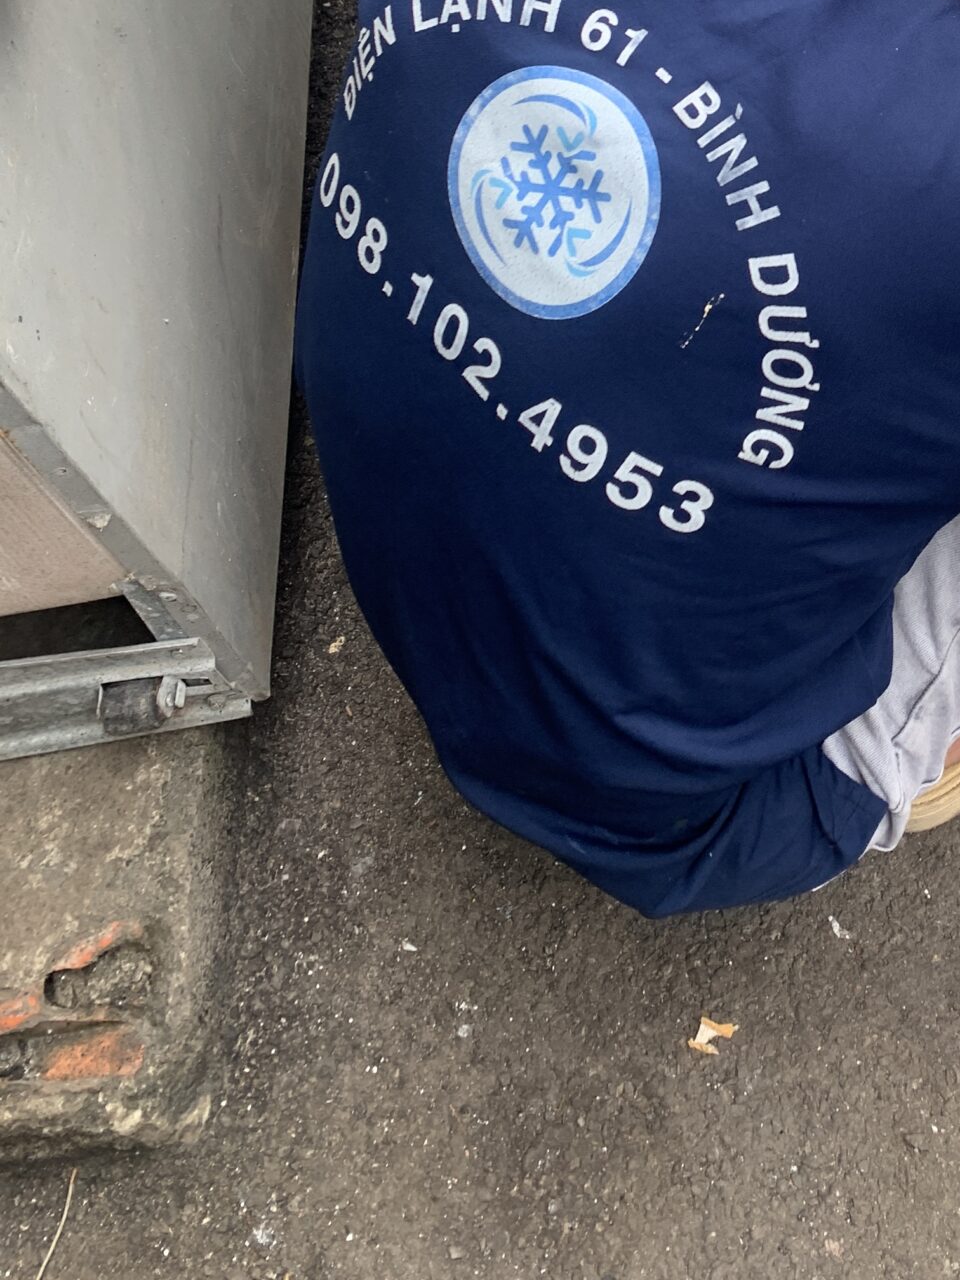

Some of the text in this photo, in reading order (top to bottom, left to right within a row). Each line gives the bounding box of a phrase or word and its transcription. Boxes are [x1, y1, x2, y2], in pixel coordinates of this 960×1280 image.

[319, 152, 714, 533] 098.102.4953
[343, 4, 397, 121] ĐIỆN
[580, 8, 649, 67] 61
[672, 80, 781, 231] BÌNH
[737, 252, 821, 469] DƯƠNG
